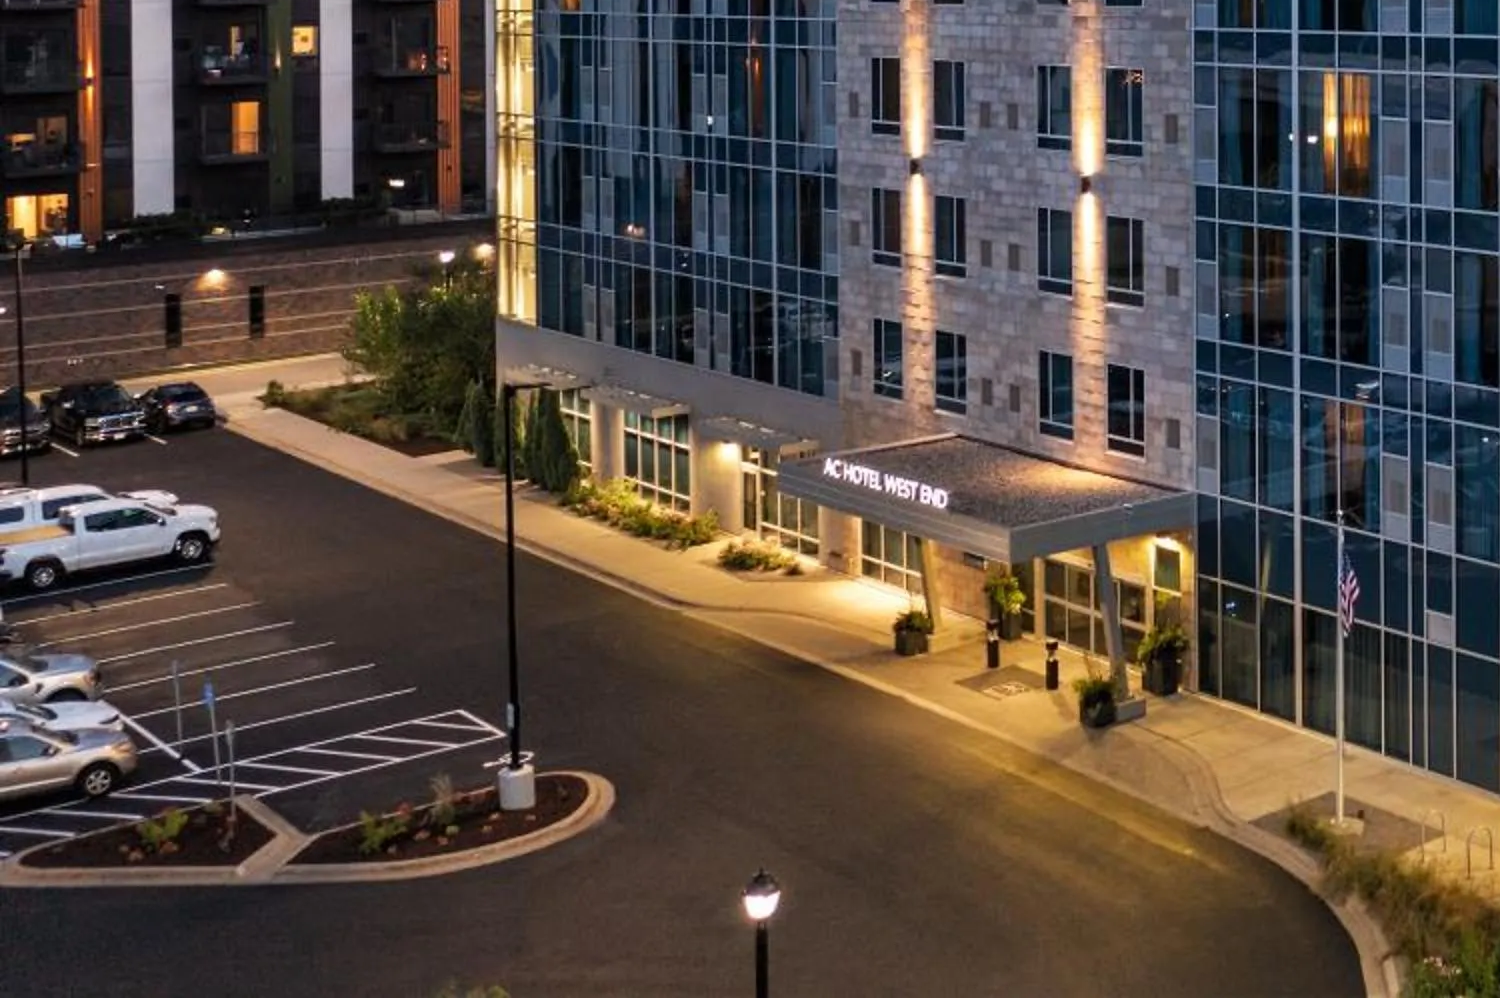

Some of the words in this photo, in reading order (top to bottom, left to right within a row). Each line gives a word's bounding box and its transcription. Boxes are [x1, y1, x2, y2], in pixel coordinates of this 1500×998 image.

[823, 458, 841, 478] AC
[843, 465, 881, 491] HOTEL
[884, 474, 918, 502] WEST
[920, 484, 949, 509] END
